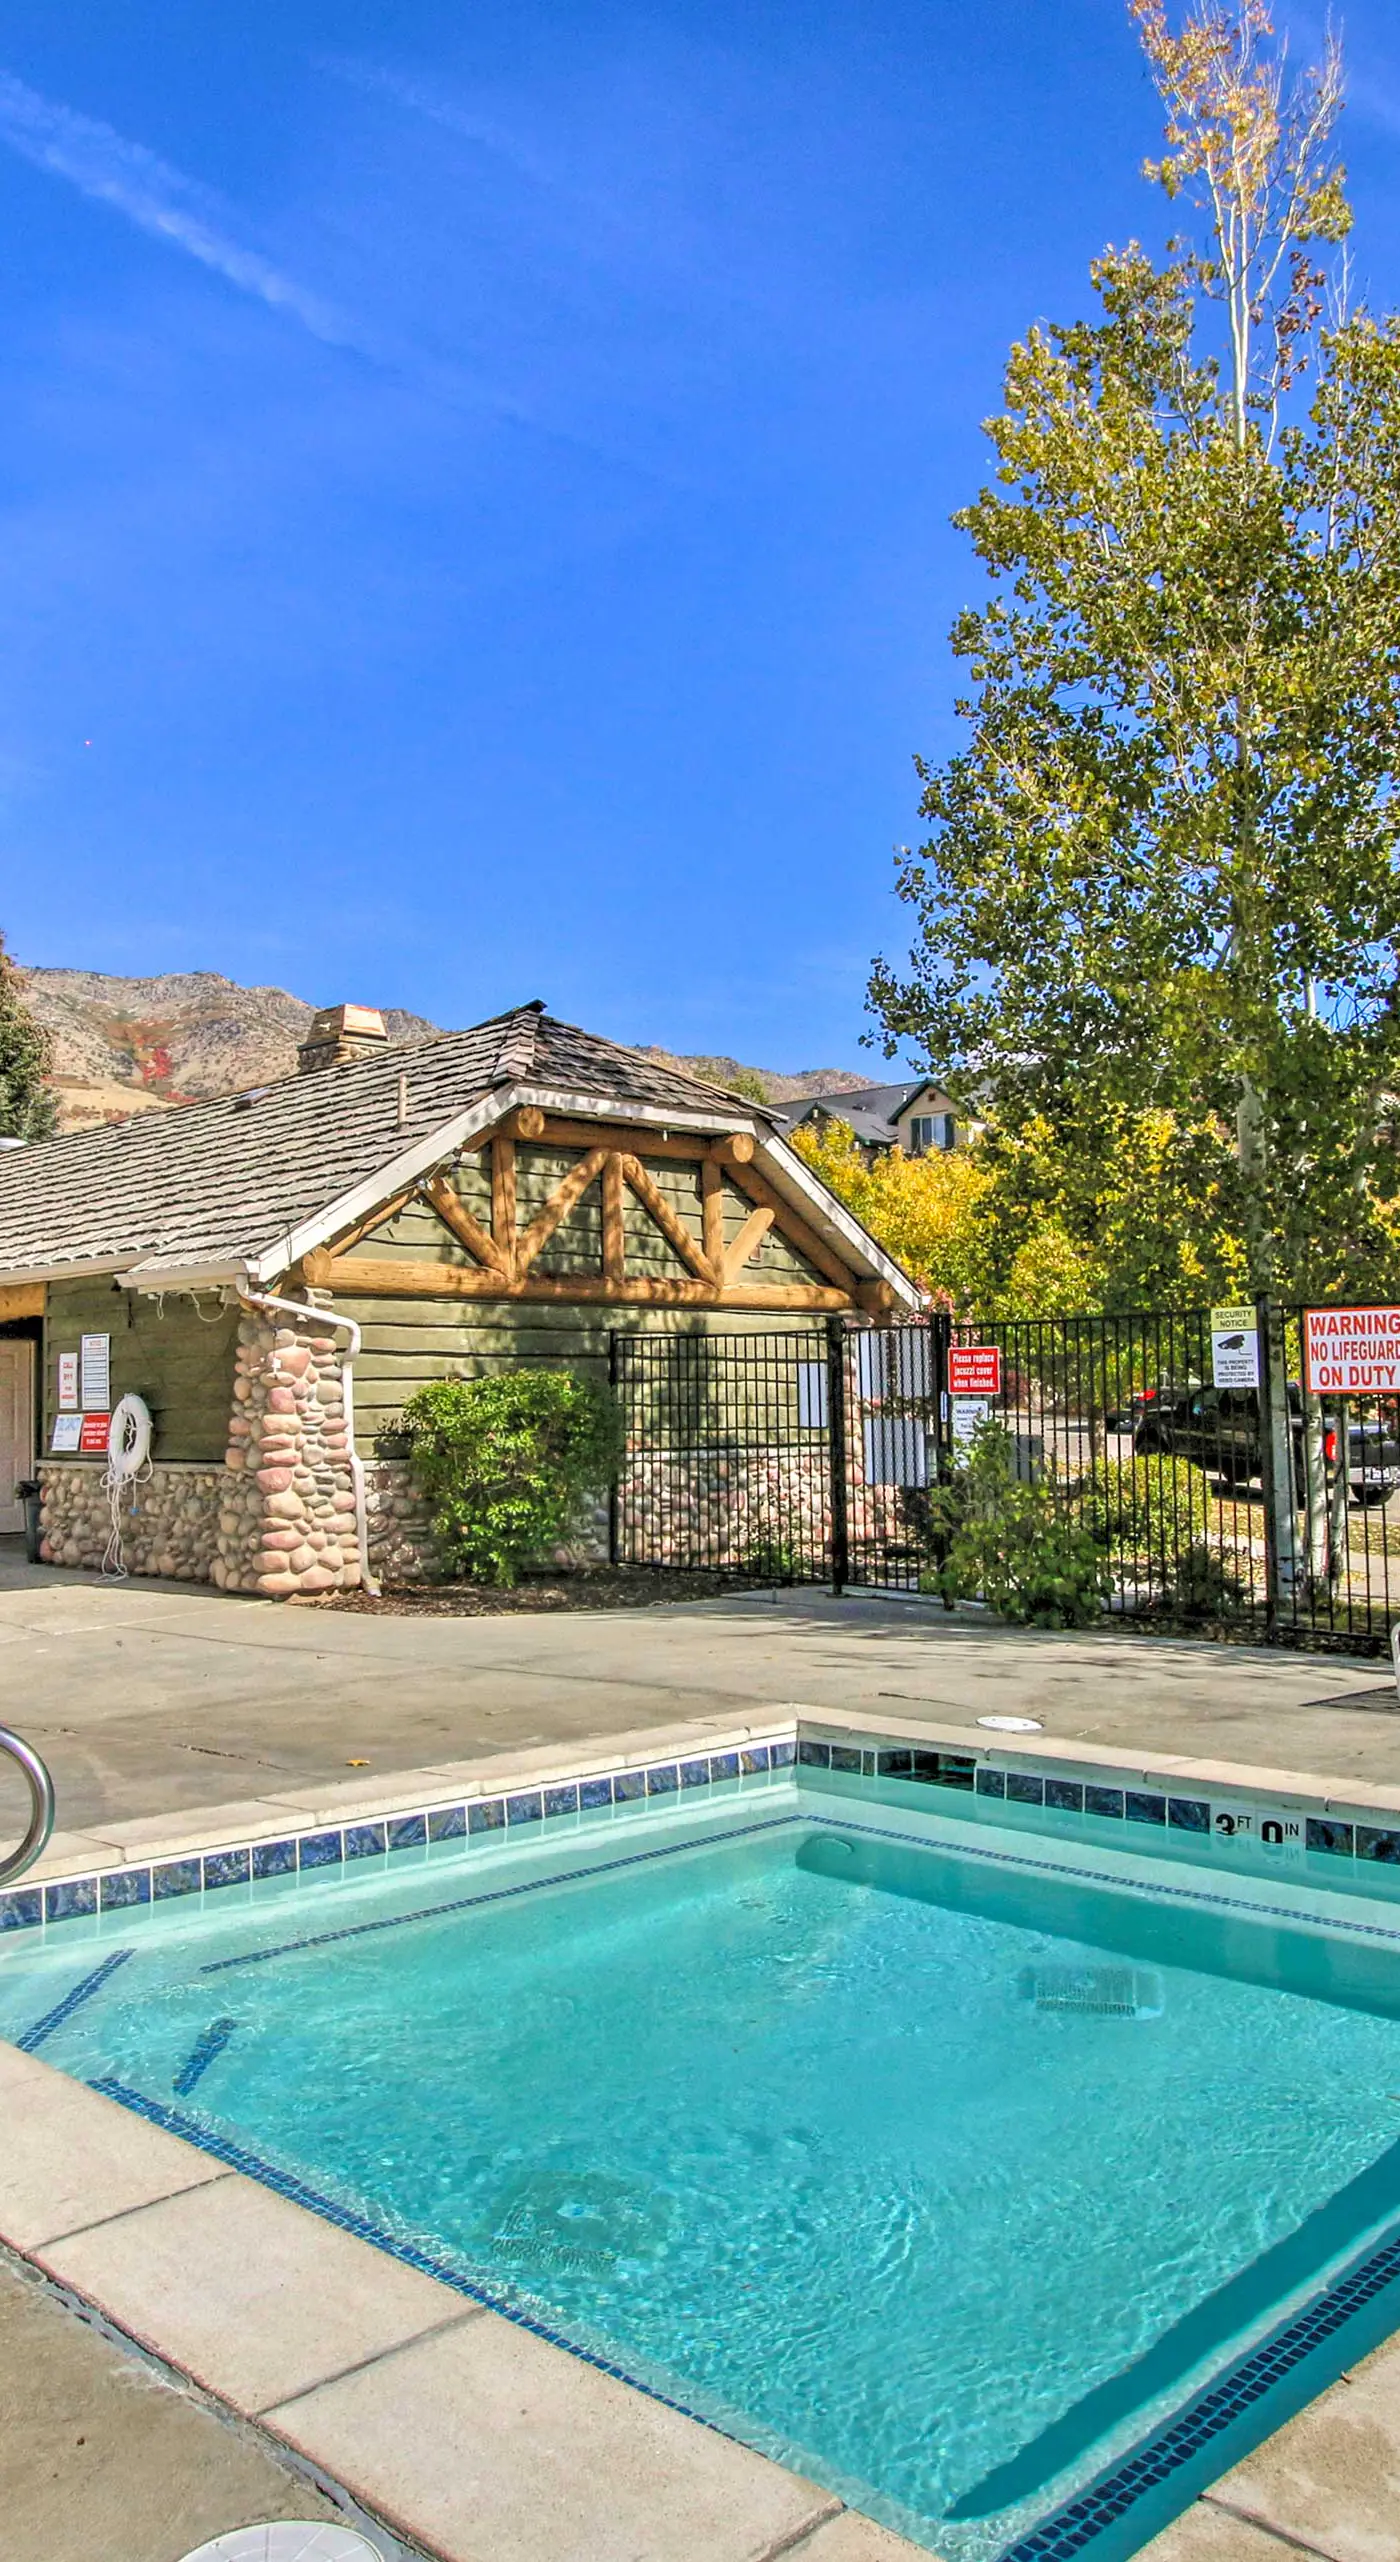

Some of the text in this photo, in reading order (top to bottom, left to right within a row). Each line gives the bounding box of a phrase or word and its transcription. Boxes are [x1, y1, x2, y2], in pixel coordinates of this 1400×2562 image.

[1215, 1310, 1252, 1319] SECURITY
[1220, 1319, 1248, 1328] NOTICE
[1310, 1313, 1400, 1336] WARNING
[1310, 1340, 1400, 1361] NO LIFEGUARD
[953, 1353, 994, 1363] Please replace
[954, 1365, 993, 1376] jacuzzi cover
[1319, 1365, 1396, 1387] ON DUTY
[953, 1377, 996, 1388] when finished.
[1238, 1815, 1252, 1829] FT
[1285, 1822, 1299, 1836] IN
